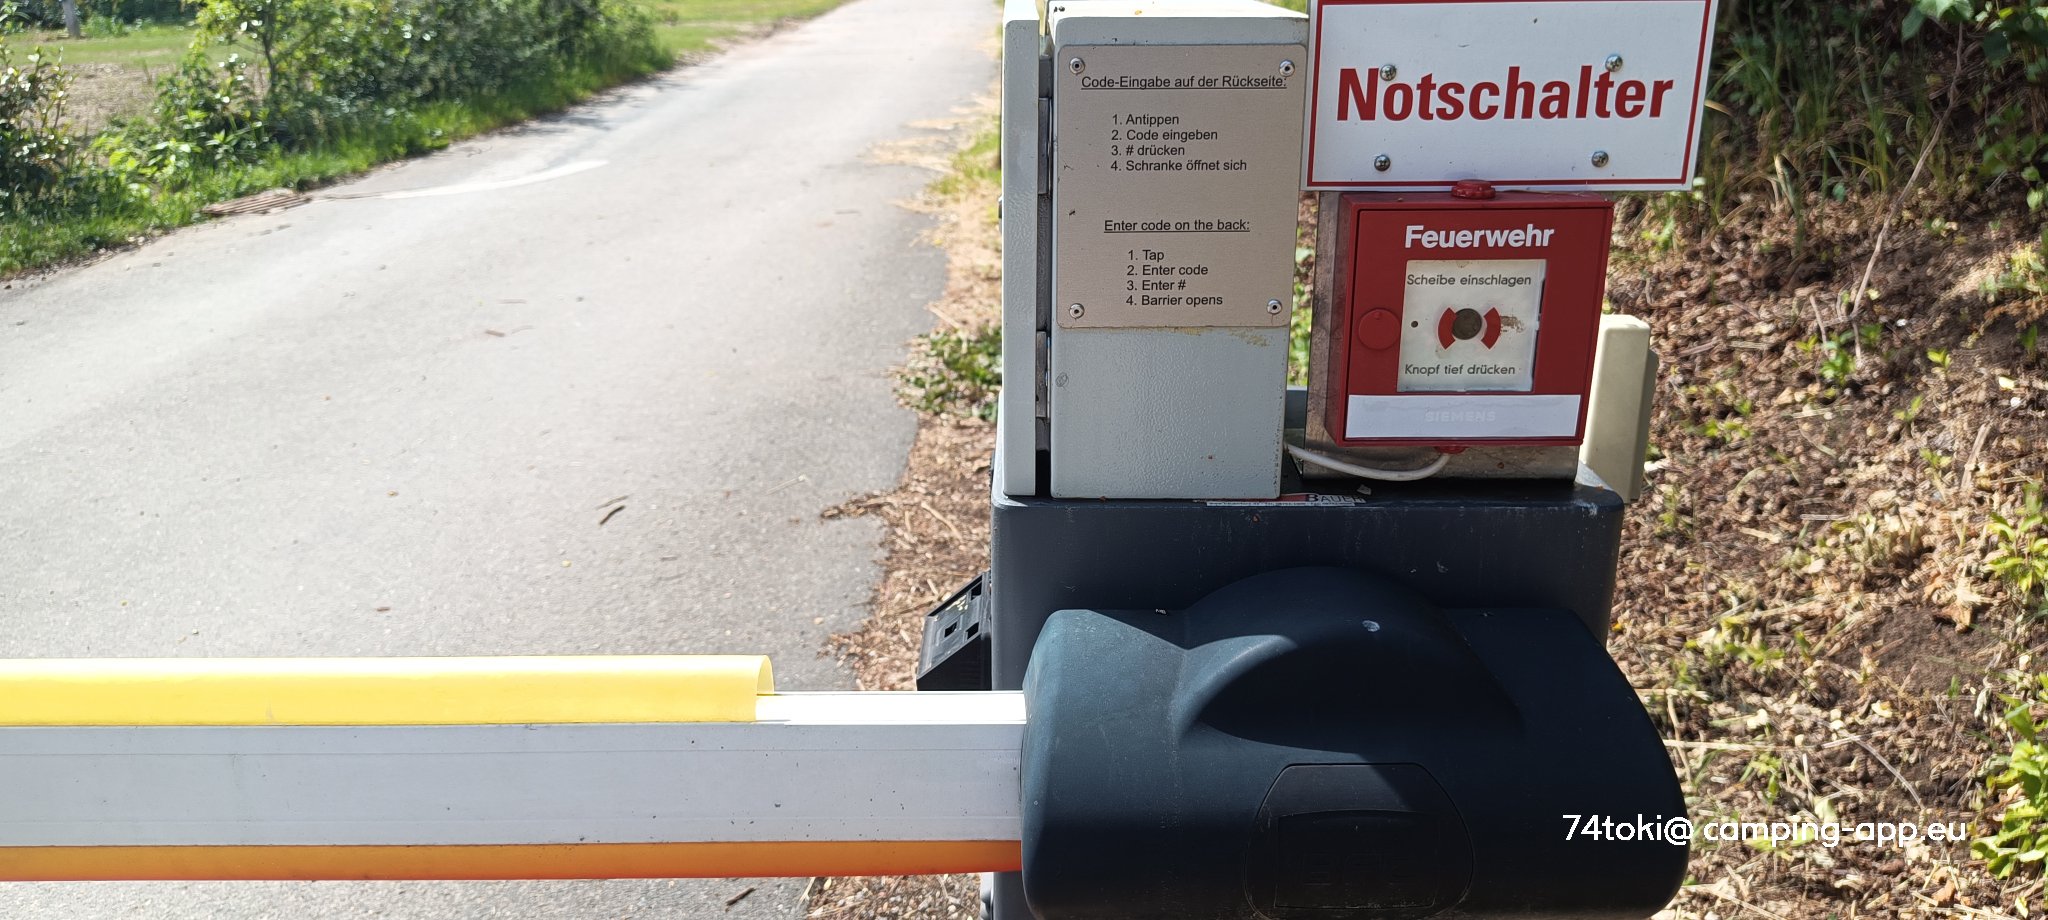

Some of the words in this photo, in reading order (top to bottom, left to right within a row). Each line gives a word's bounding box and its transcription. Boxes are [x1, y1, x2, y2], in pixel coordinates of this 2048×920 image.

[1081, 75, 1171, 90] Code-Eingabe
[1174, 75, 1195, 88] auf
[1198, 75, 1218, 88] der
[1222, 74, 1287, 88] Rückseite:
[1336, 65, 1674, 121] Notschalter
[1112, 114, 1123, 125] 1.
[1126, 114, 1180, 128] Antippen
[1111, 130, 1122, 141] 2.
[1126, 130, 1159, 141] Code
[1162, 129, 1218, 143] eingeben
[1111, 145, 1122, 156] 3.
[1126, 145, 1134, 155] #
[1137, 145, 1185, 156] drücken
[1111, 160, 1122, 171] 4.
[1126, 160, 1183, 171] Schranke
[1186, 160, 1220, 171] öffnet
[1223, 159, 1247, 171] sich
[1104, 220, 1138, 231] Enter
[1141, 220, 1171, 231] code
[1174, 222, 1190, 231] on
[1194, 220, 1214, 231] the
[1217, 219, 1250, 231] back:
[1404, 223, 1555, 249] Feuerwehr
[1128, 250, 1138, 261] 1.
[1142, 250, 1164, 263] Tap
[1127, 265, 1138, 276] 2.
[1142, 265, 1175, 276] Enter
[1178, 265, 1208, 275] code
[1126, 280, 1137, 291] 3.
[1142, 280, 1175, 291] Enter
[1178, 279, 1186, 290] #
[1407, 275, 1456, 286] Scheibe
[1460, 274, 1531, 288] einschlagen
[1126, 295, 1137, 306] 4.
[1141, 295, 1181, 306] Barrier
[1185, 295, 1223, 308] opens
[1404, 364, 1440, 377] Knopf
[1444, 364, 1464, 376] tief
[1467, 364, 1515, 376] drücken
[1425, 410, 1497, 423] SIEMENS
